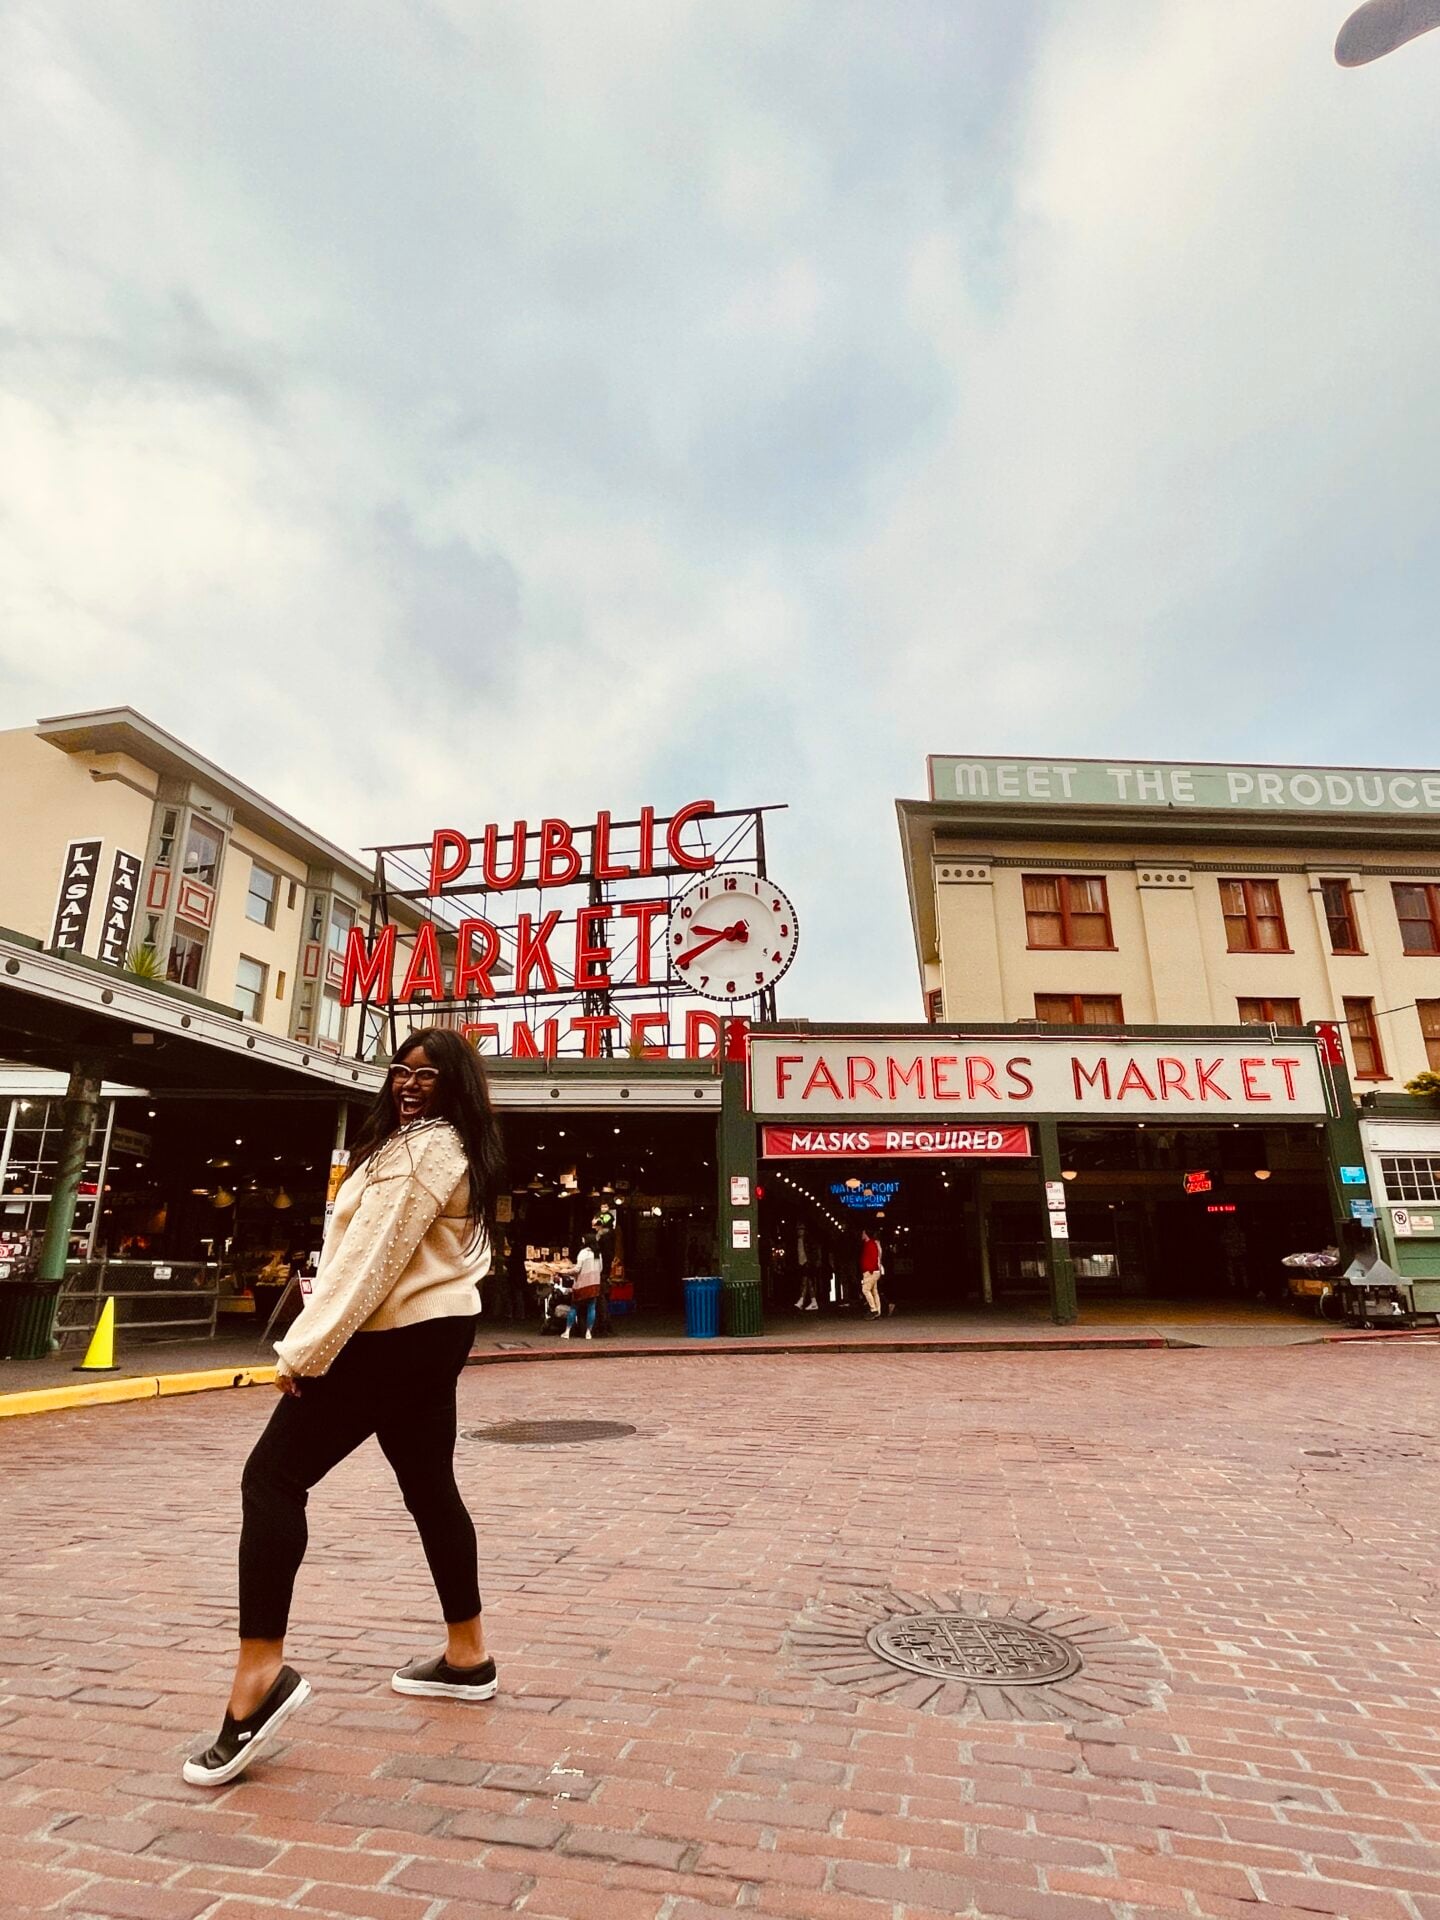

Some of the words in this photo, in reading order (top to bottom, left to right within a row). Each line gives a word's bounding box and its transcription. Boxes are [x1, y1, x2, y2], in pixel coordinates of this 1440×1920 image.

[954, 763, 1077, 798] MEET
[1106, 768, 1195, 801] THE
[1226, 772, 1440, 808] PRODUCE
[68, 847, 93, 878] LA
[428, 800, 715, 897] PUBLIC
[115, 855, 135, 890] LA
[101, 895, 130, 967] SALL
[340, 901, 669, 1007] MARKET
[776, 1056, 1034, 1100] FARMERS
[1071, 1057, 1301, 1100] MARKET
[791, 1132, 870, 1152] MASKS
[886, 1131, 1003, 1151] REQUIRED
